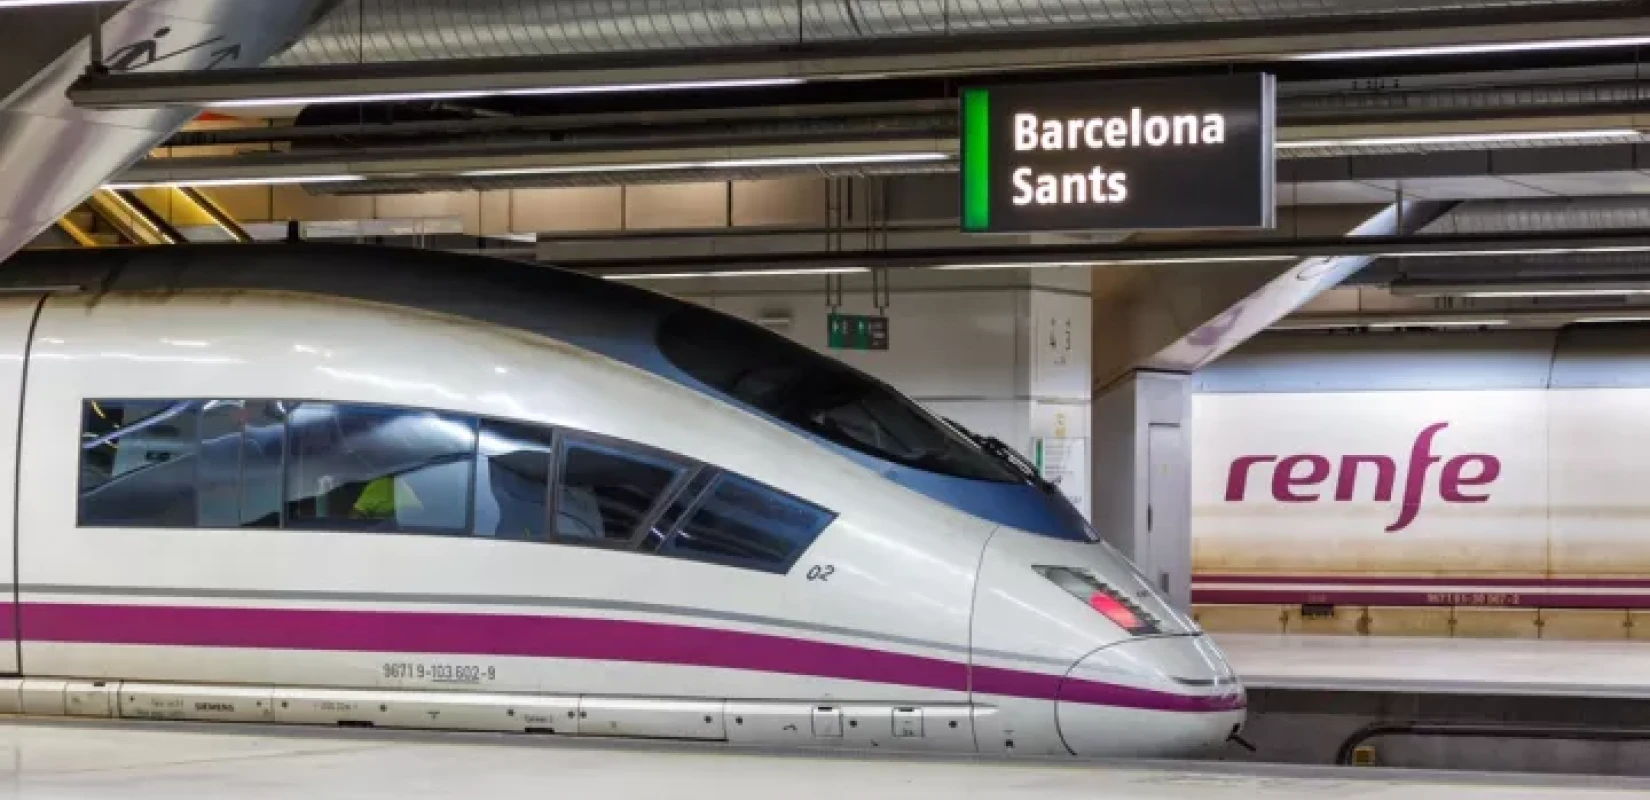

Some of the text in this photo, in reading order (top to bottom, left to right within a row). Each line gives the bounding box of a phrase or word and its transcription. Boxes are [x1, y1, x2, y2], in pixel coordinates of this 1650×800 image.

[1013, 106, 1226, 151] Barcelona
[1011, 165, 1128, 206] Sants
[1224, 421, 1501, 533] renfe
[806, 564, 835, 582] 02
